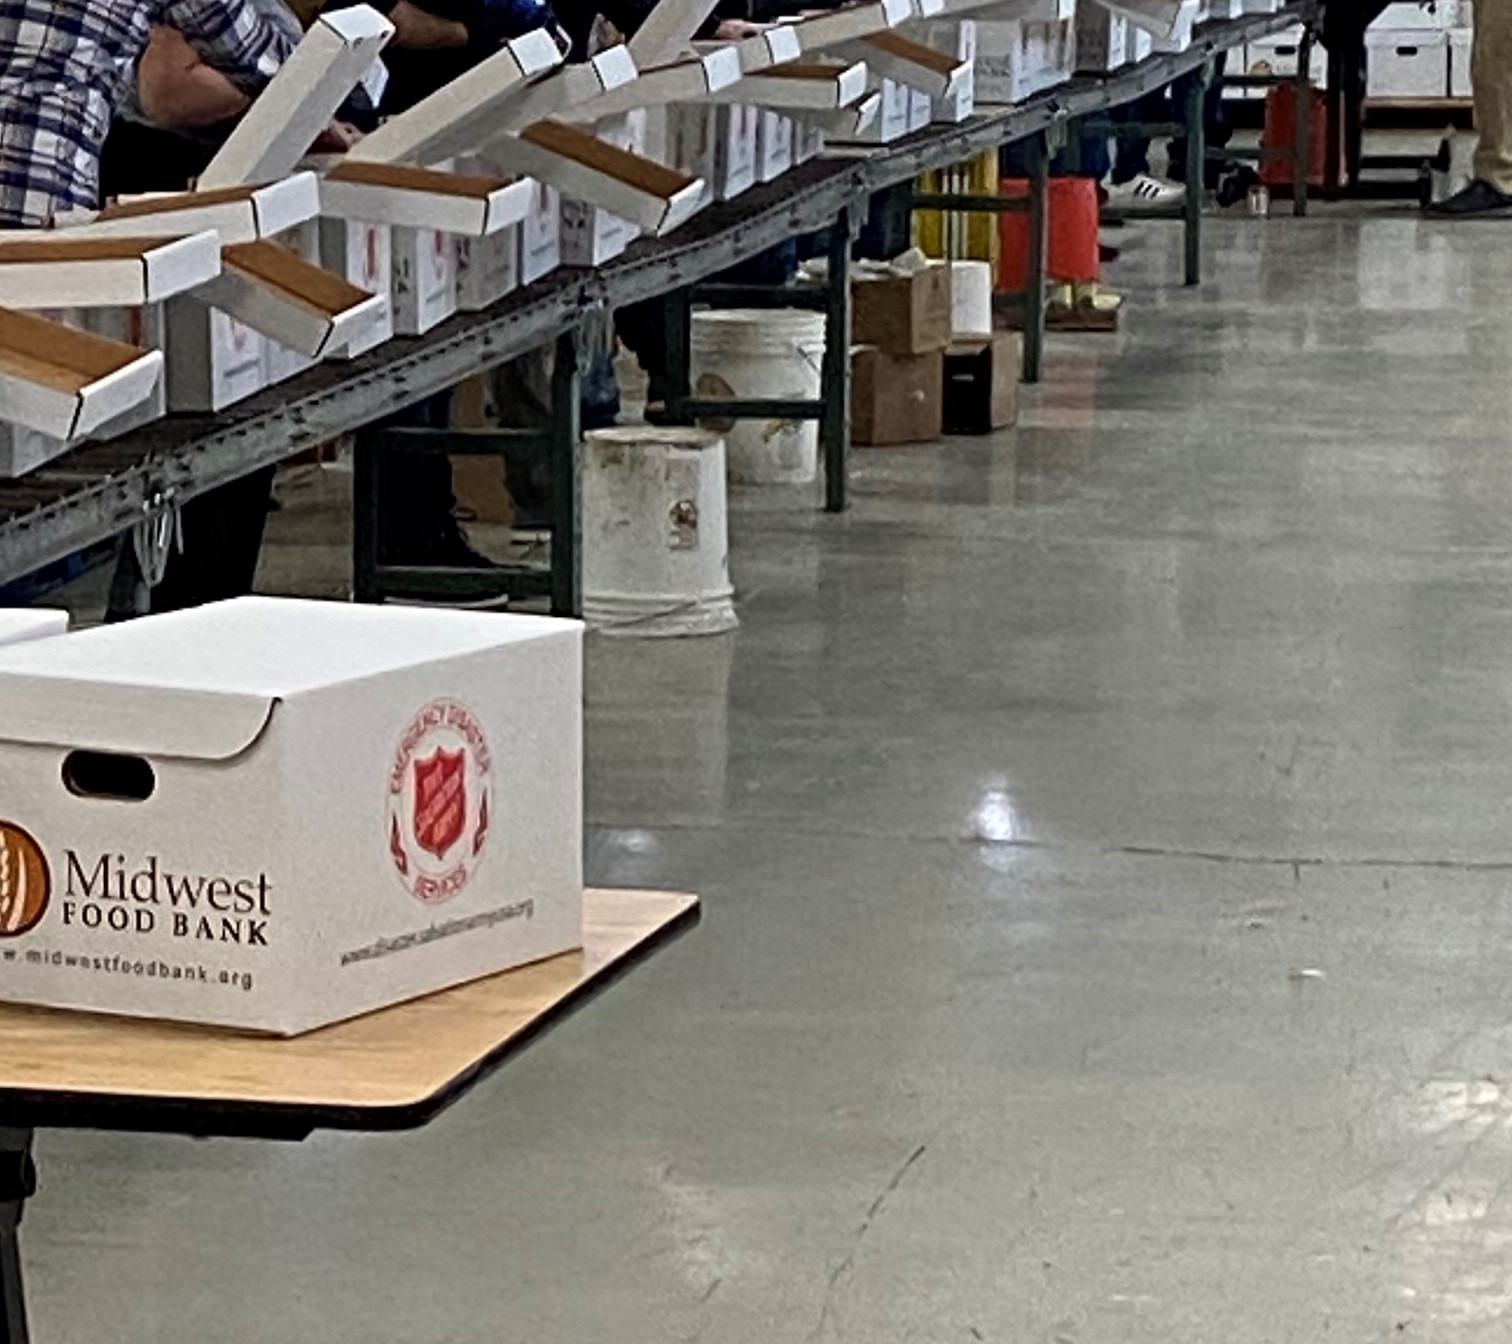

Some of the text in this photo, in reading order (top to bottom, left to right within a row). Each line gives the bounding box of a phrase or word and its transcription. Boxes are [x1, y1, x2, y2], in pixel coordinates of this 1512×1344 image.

[64, 850, 272, 915] Midwest
[64, 903, 268, 946] FOOD BANK
